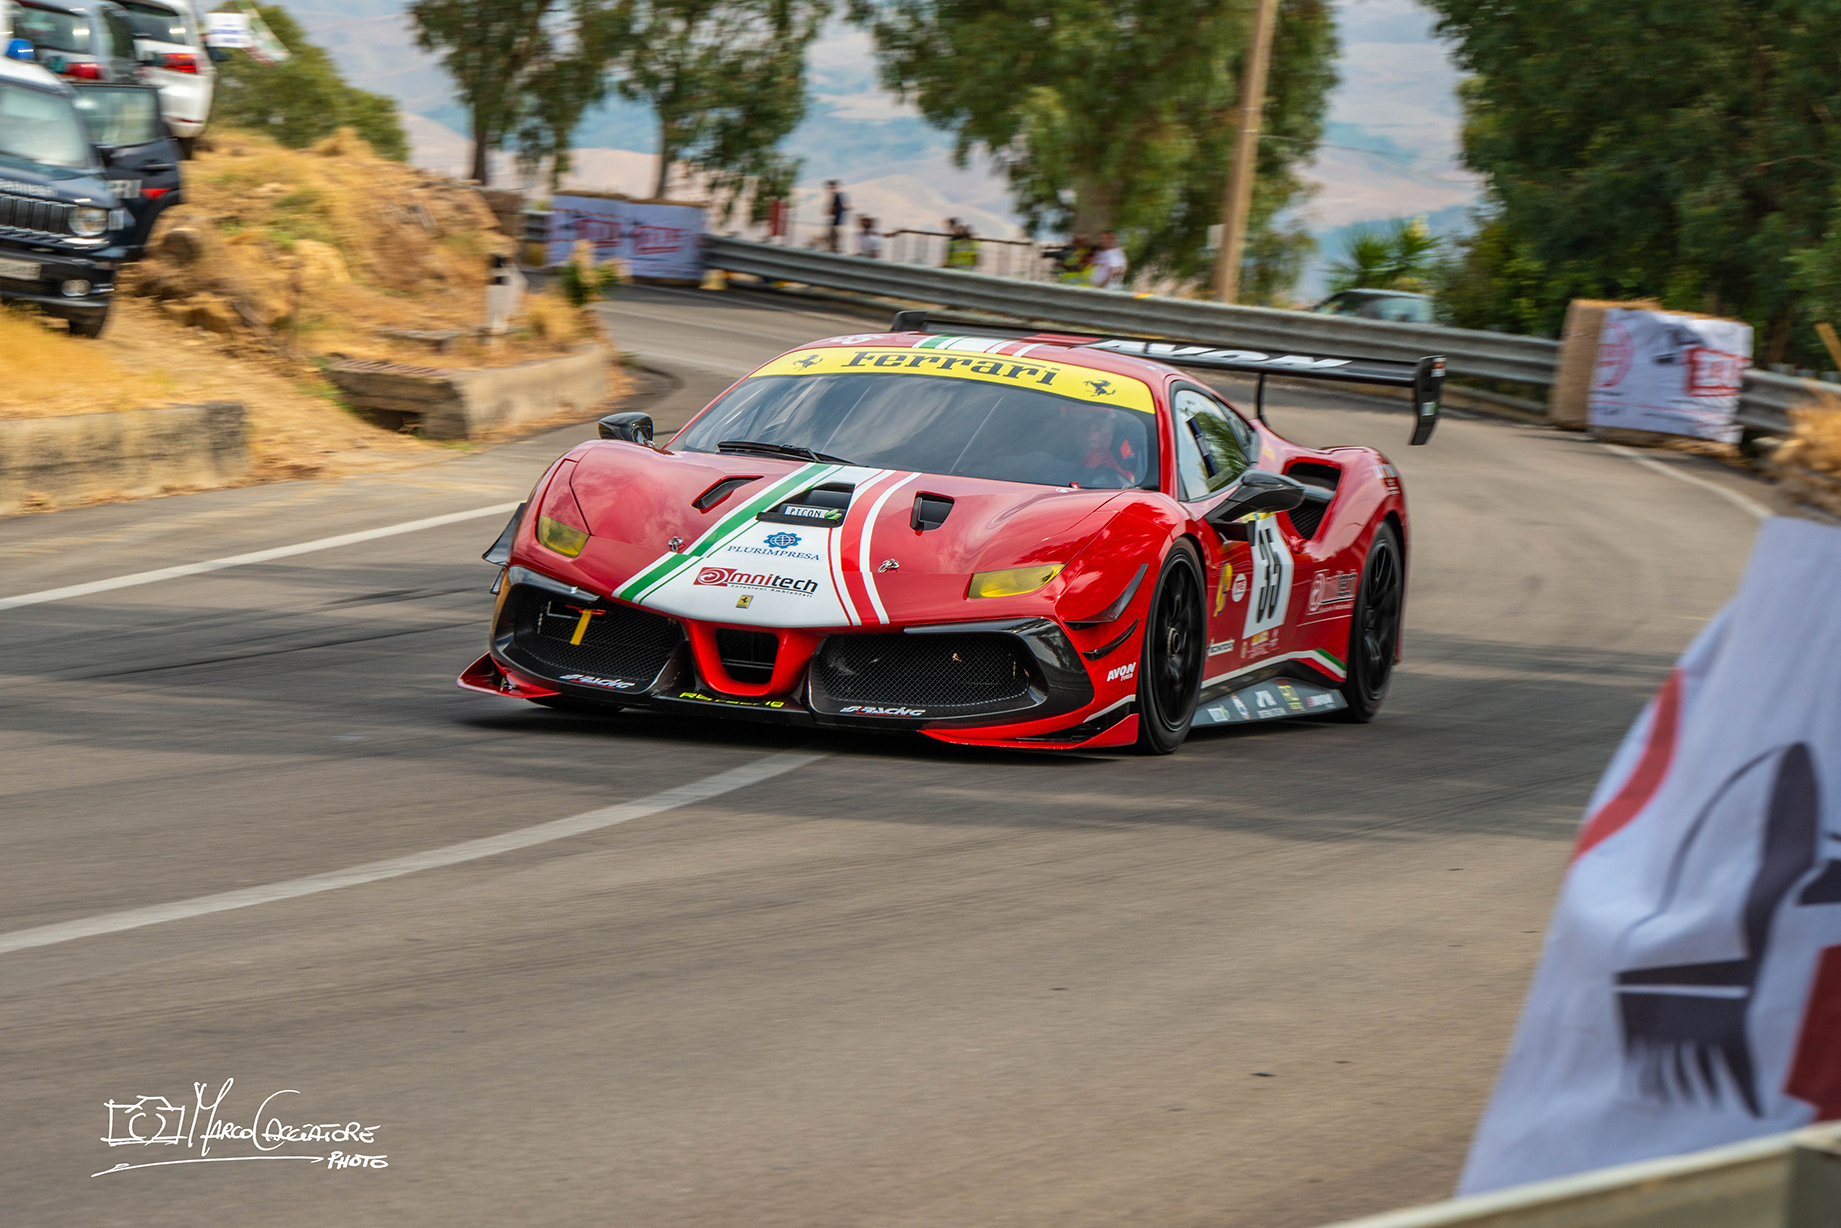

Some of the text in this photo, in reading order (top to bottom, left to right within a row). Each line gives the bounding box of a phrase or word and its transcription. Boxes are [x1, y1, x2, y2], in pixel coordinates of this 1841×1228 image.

[841, 351, 1061, 386] Ferrari
[727, 545, 820, 561] PLURIMPRESA
[1106, 661, 1137, 682] AVON
